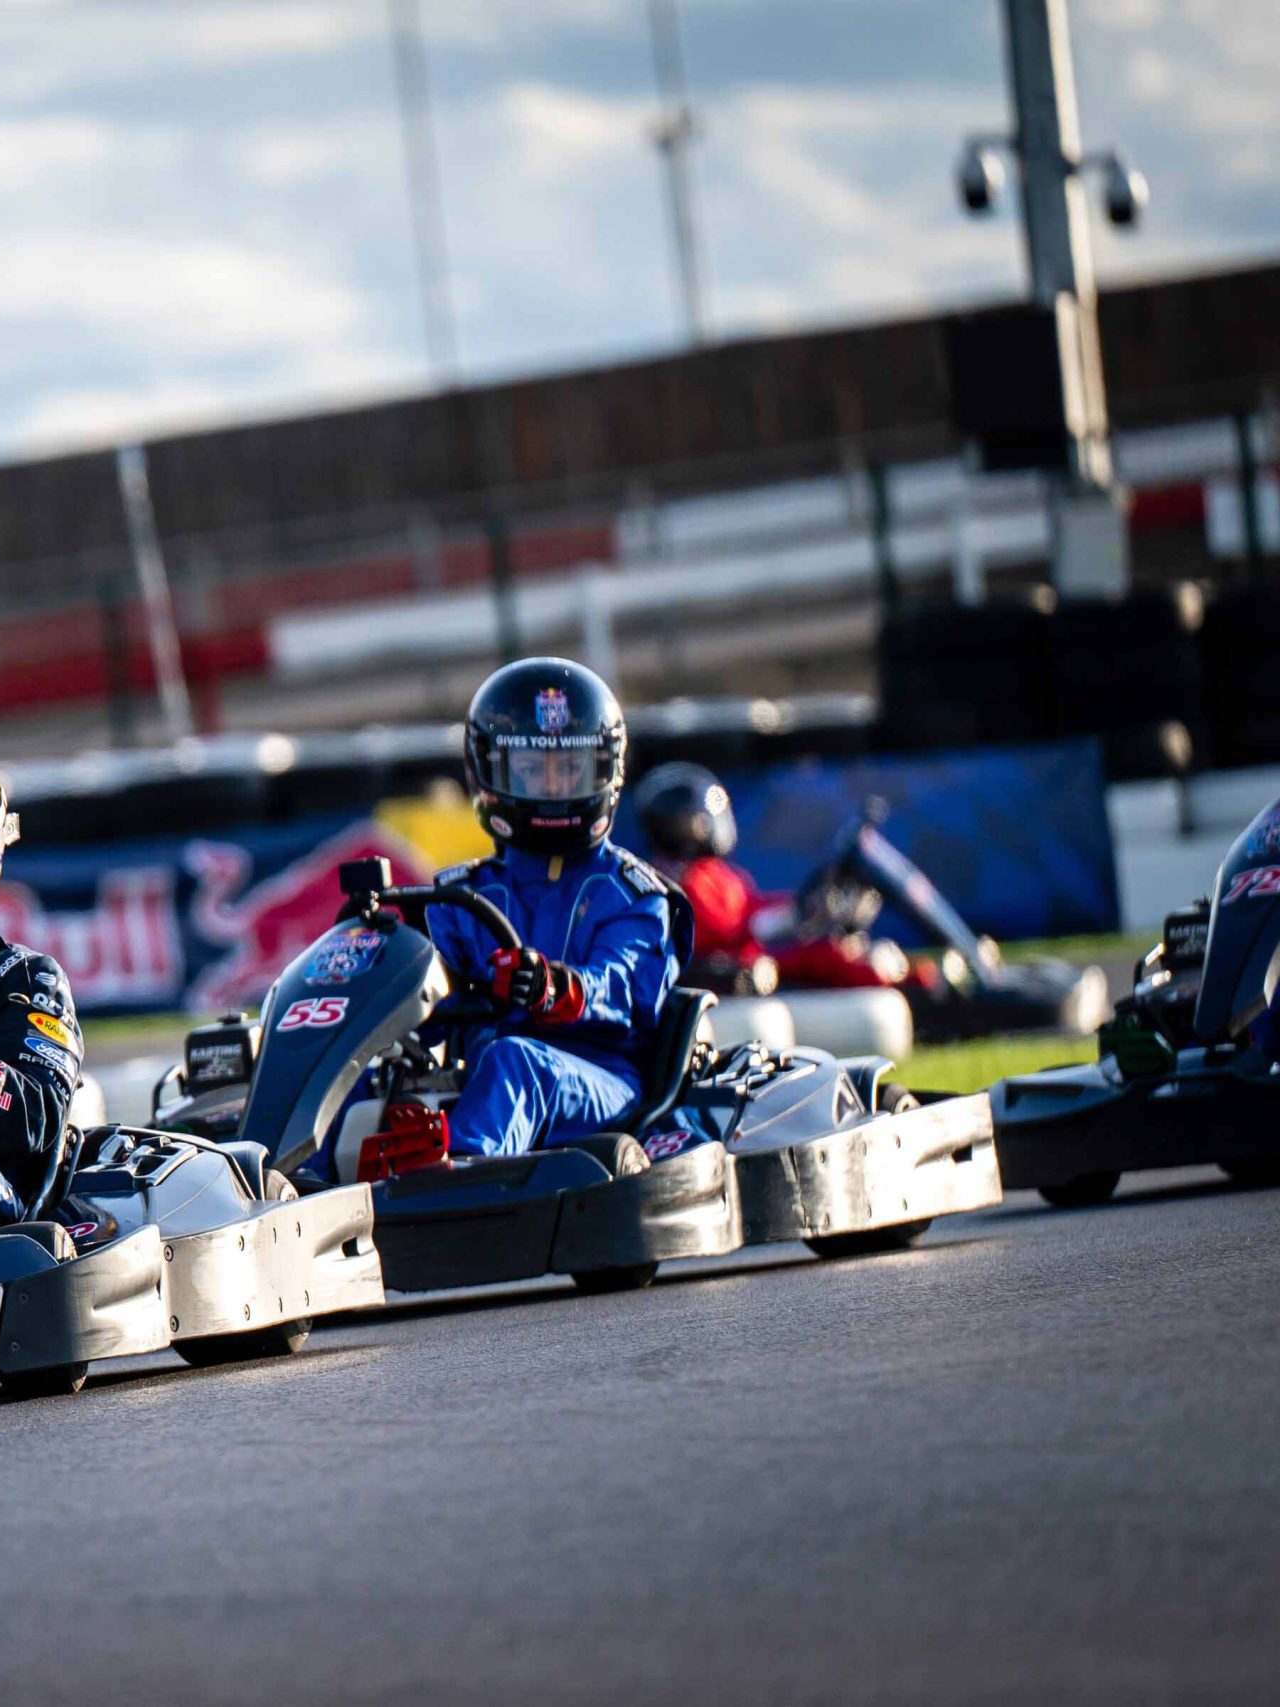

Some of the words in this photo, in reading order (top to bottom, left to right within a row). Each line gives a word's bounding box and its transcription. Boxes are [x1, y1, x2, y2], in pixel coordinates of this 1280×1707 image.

[496, 734, 527, 746] GIVES
[530, 735, 557, 748] YOU
[277, 997, 349, 1032] 55
